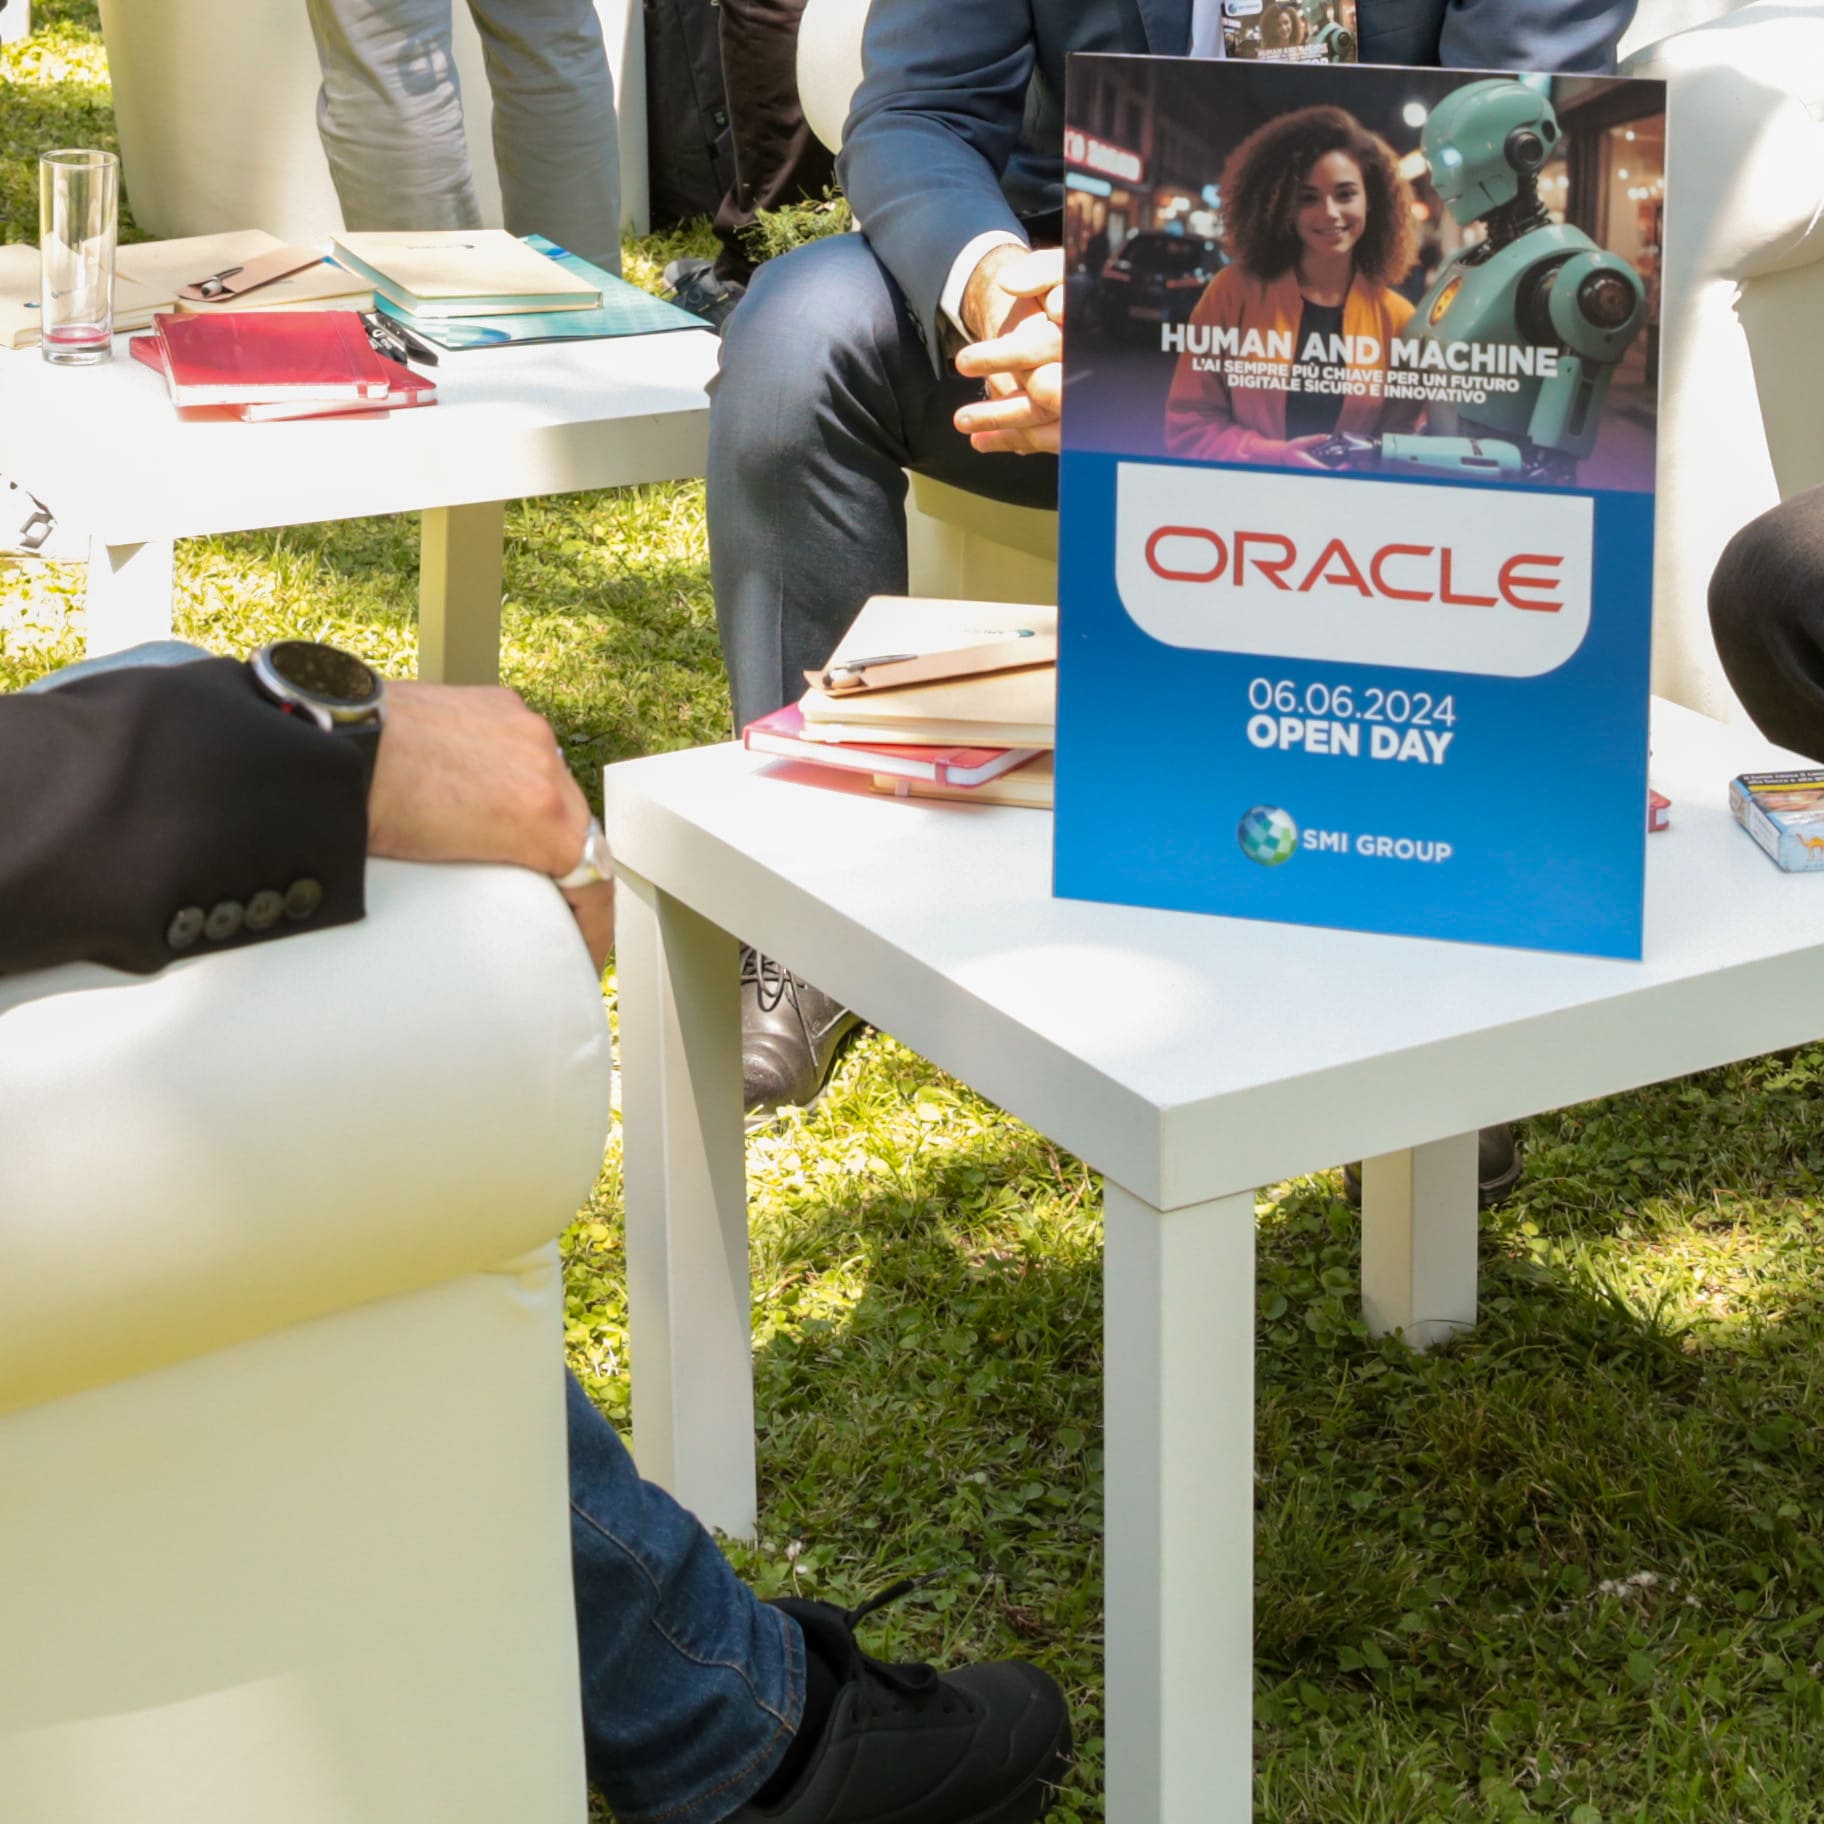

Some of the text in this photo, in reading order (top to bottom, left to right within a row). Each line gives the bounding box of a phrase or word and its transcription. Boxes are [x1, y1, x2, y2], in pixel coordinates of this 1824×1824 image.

[1161, 323, 1558, 377] HUMAN AND MACHINE
[1193, 358, 1520, 392] L'AI SEMPRE PIÙ CHIAVE PER UN FUTURO
[1227, 373, 1486, 404] DIGITALE SICURO E INNOVATIVO
[1145, 525, 1565, 613] ORACLE
[1248, 678, 1456, 727] 06.06.2024
[1247, 714, 1454, 765] OPEN DAY
[1303, 829, 1452, 863] SMI GROUP
